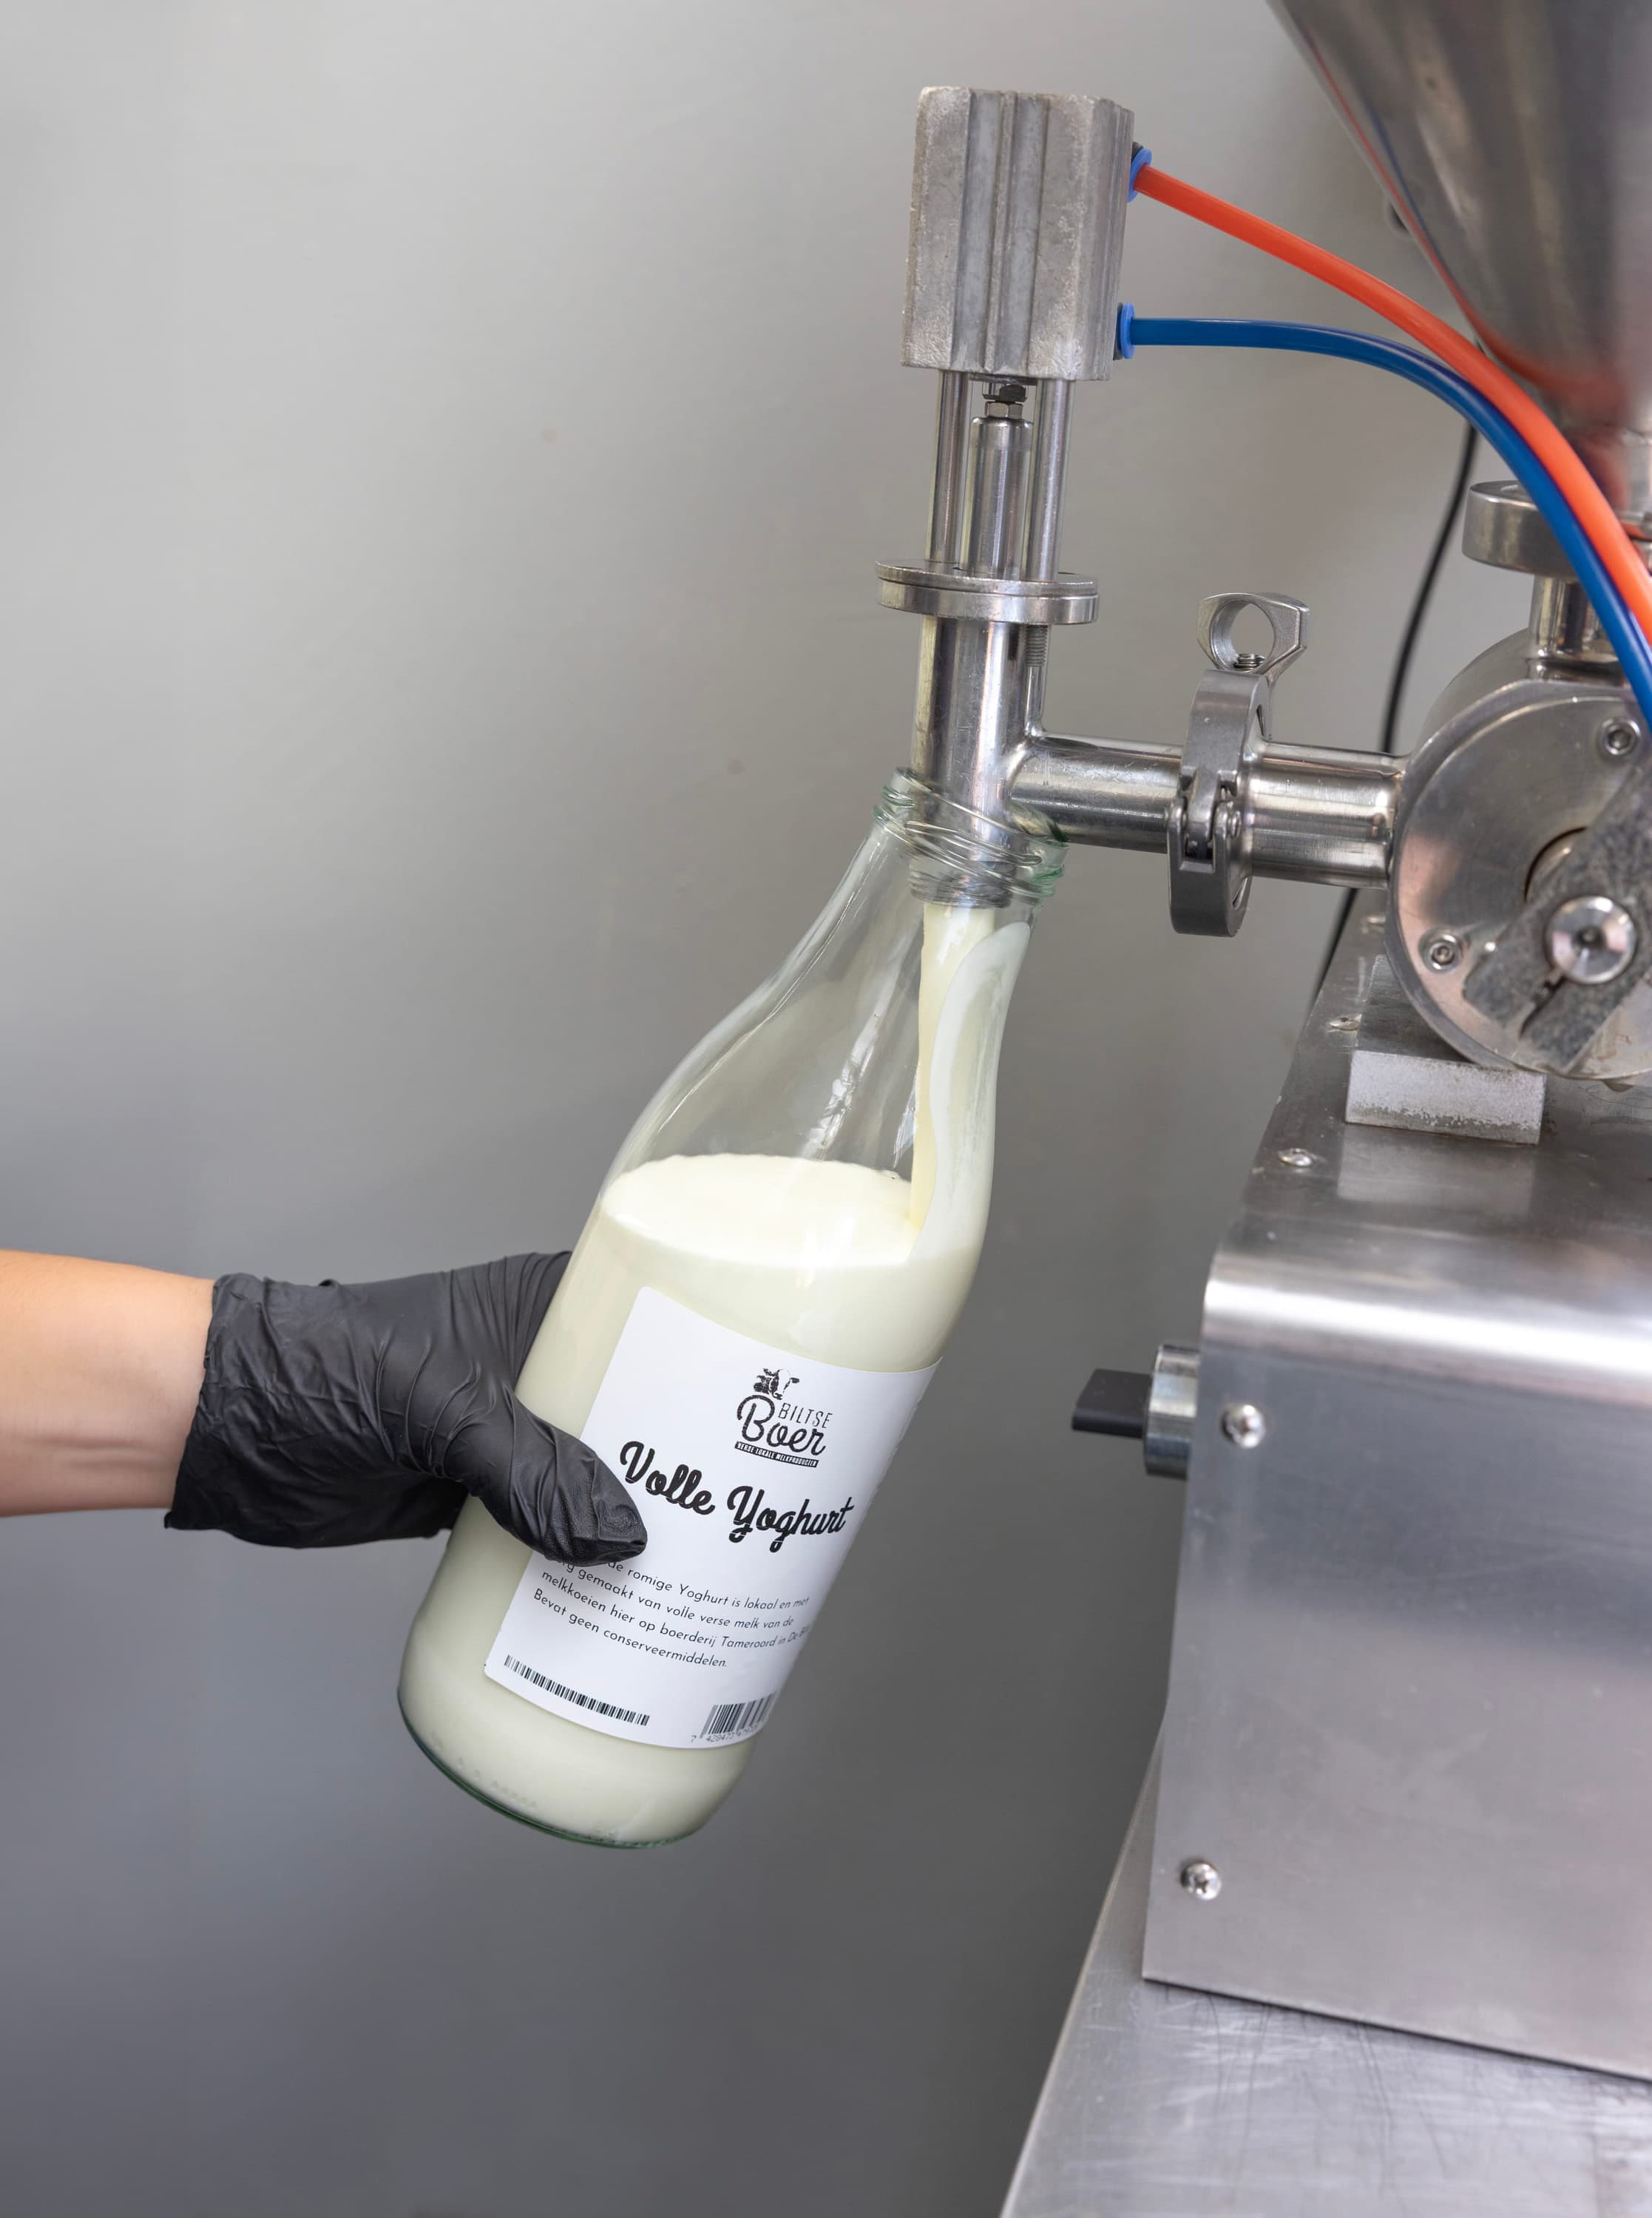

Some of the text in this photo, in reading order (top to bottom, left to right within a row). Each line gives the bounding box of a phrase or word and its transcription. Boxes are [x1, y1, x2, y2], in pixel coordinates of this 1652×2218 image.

[737, 1395, 826, 1455] Boer
[778, 1402, 833, 1428] BILTSE
[755, 1447, 775, 1458] LOKALE
[620, 1441, 855, 1553] Volle Yoghurt
[541, 1572, 606, 1612] melkkoeien
[610, 1603, 635, 1623] hier
[639, 1620, 656, 1632] op
[660, 1622, 717, 1648] boerderij
[721, 1635, 778, 1649] Tameroord
[578, 1569, 794, 1629] gemaakt van volle verse melk van de
[627, 1569, 673, 1591] romige
[680, 1583, 728, 1605] Yoghurt
[731, 1597, 741, 1607] is
[744, 1597, 779, 1609] lokaal
[779, 1601, 791, 1609] en
[534, 1588, 727, 1668] Bevat geen conserveermiddelen.
